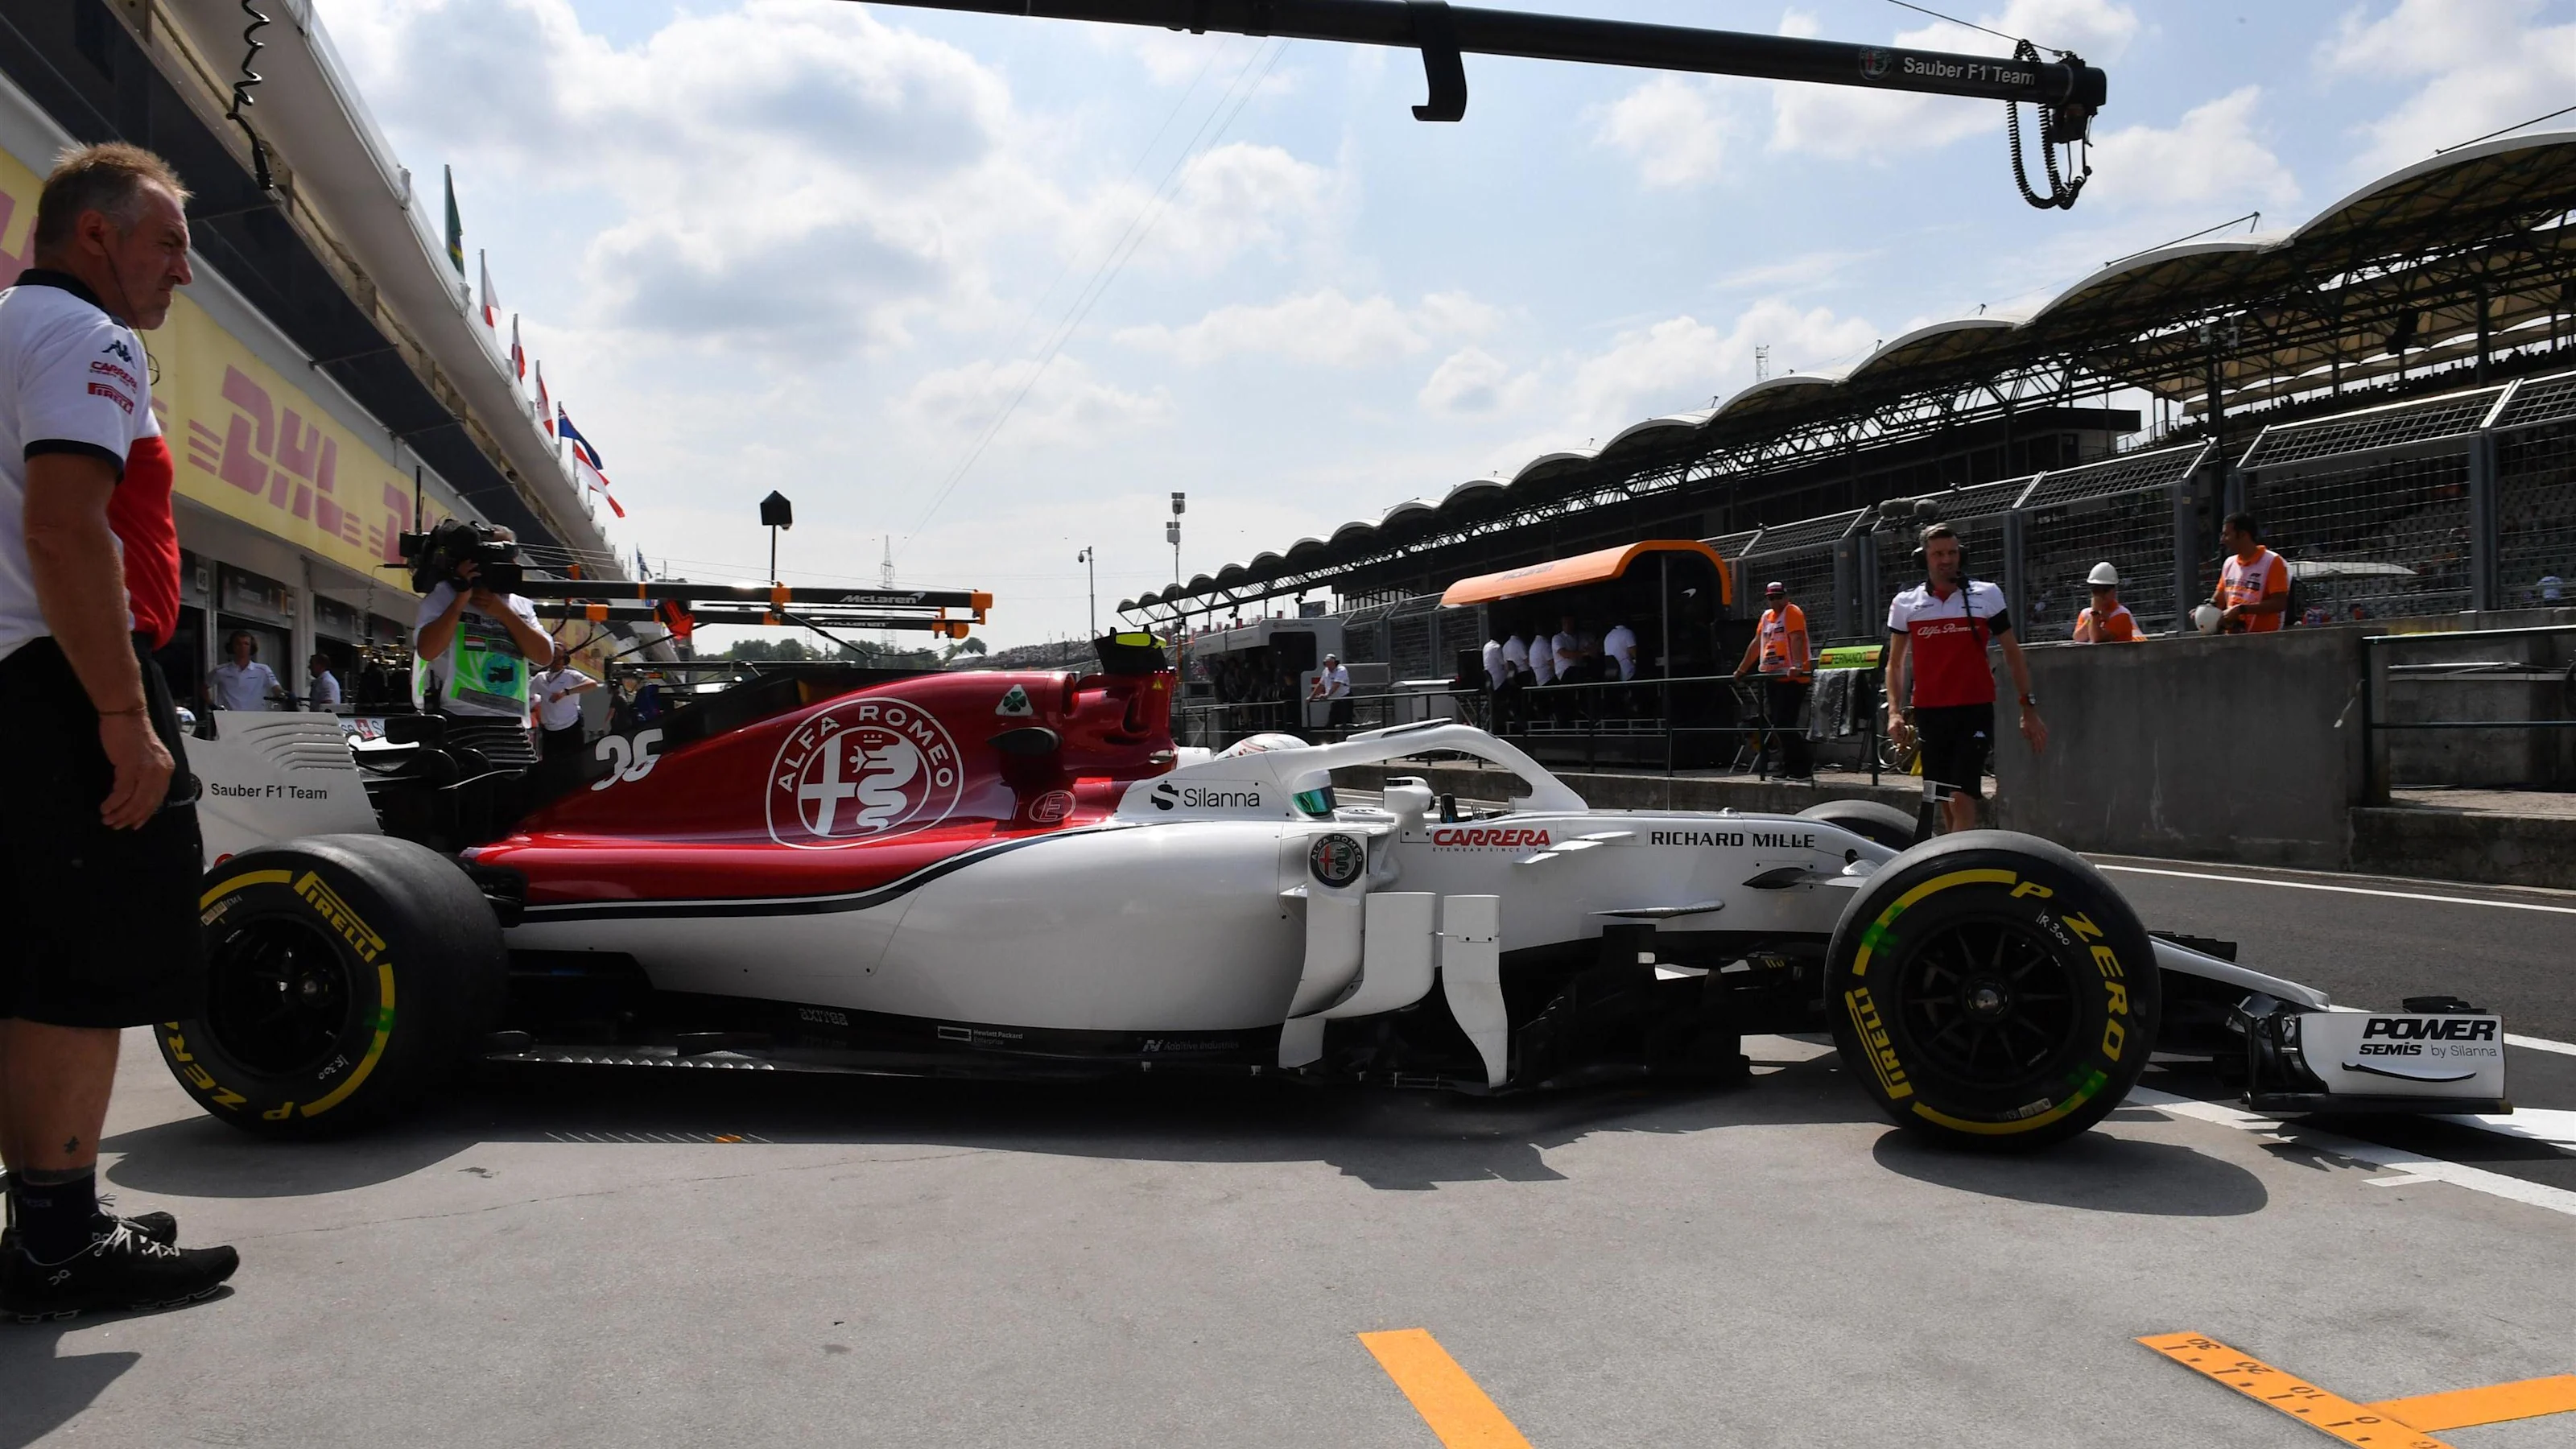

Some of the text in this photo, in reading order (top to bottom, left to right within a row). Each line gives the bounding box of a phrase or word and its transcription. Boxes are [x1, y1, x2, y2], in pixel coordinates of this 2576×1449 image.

[1903, 56, 1963, 78] Sauber
[1992, 66, 2036, 85] Team
[219, 363, 344, 538] DHL
[840, 594, 917, 604] McLaren
[1918, 625, 1942, 638] Alfa
[778, 705, 953, 793] ALFA ROMEO
[591, 728, 663, 791] 36
[211, 783, 262, 798] Sauber
[288, 786, 328, 799] Team
[1183, 787, 1260, 807] Silanna
[1433, 828, 1550, 846] CARRERA
[1651, 832, 1815, 848] RICHARD MILLE
[1311, 836, 1362, 862] ALFA ROMEO
[293, 870, 386, 963] PIRELLI
[2049, 923, 2070, 946] 300
[2009, 881, 2128, 1062] P ZERO
[998, 1030, 1023, 1039] Packard
[2363, 1018, 2497, 1041] POWER
[1844, 987, 1913, 1100] PIRELLI
[2431, 1044, 2446, 1058] by
[2450, 1045, 2497, 1056] Silanna
[262, 1101, 294, 1121] P
[2186, 1338, 2222, 1351] 30
[2234, 1361, 2275, 1375] 20
